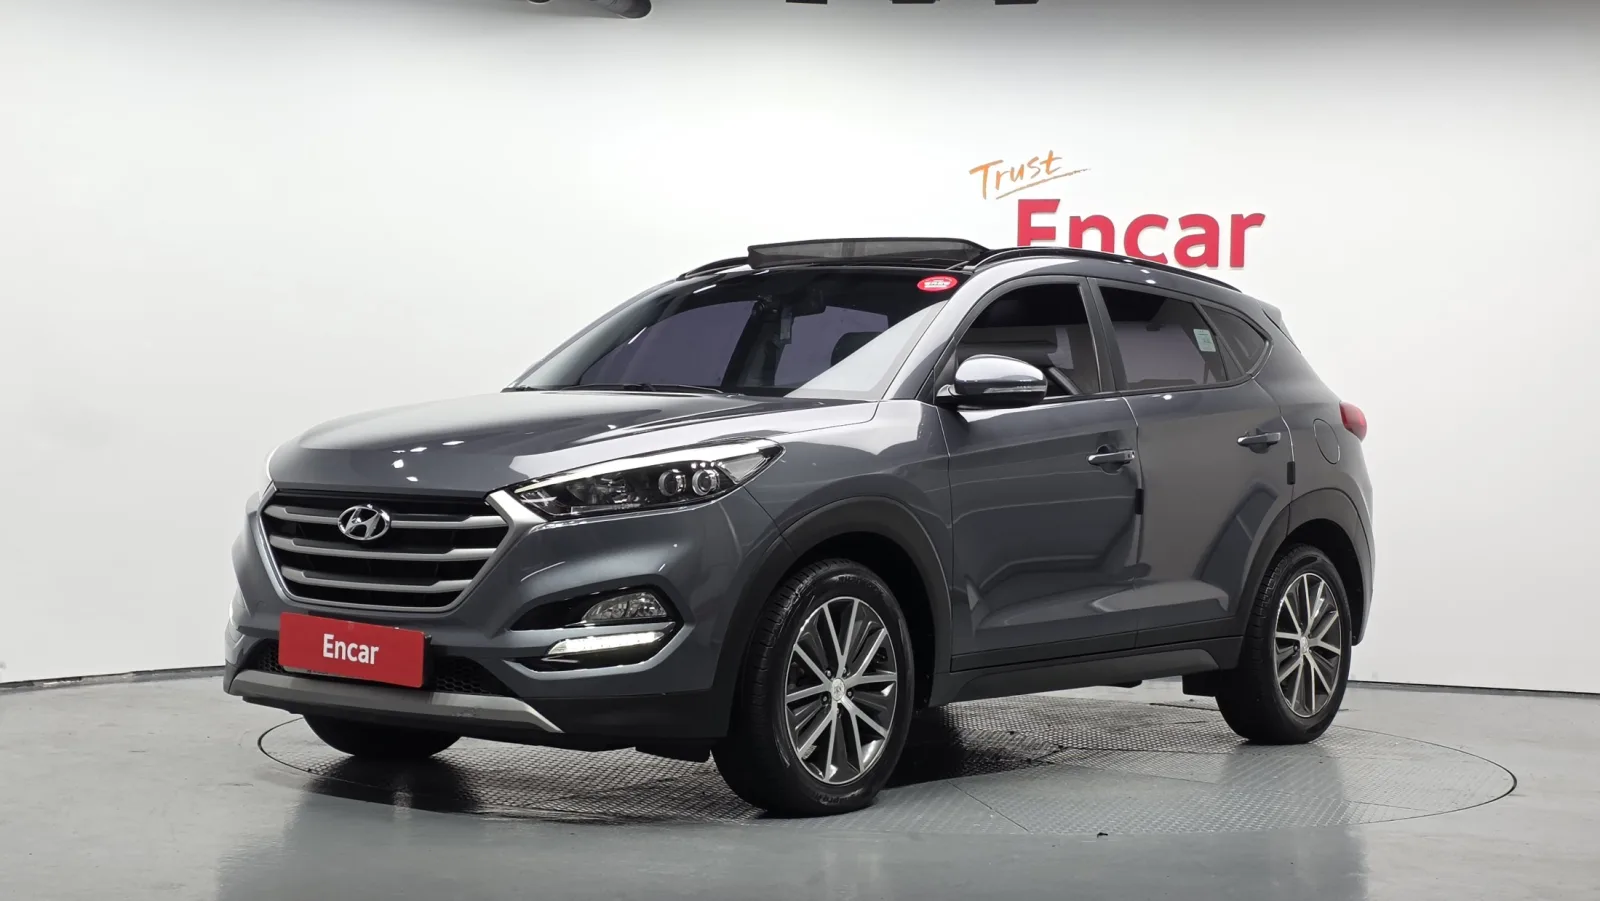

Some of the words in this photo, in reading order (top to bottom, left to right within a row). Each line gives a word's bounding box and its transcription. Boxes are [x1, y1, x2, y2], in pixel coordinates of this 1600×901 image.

[969, 150, 1063, 199] Trust
[1017, 198, 1266, 268] Encar
[322, 633, 380, 665] Encar
